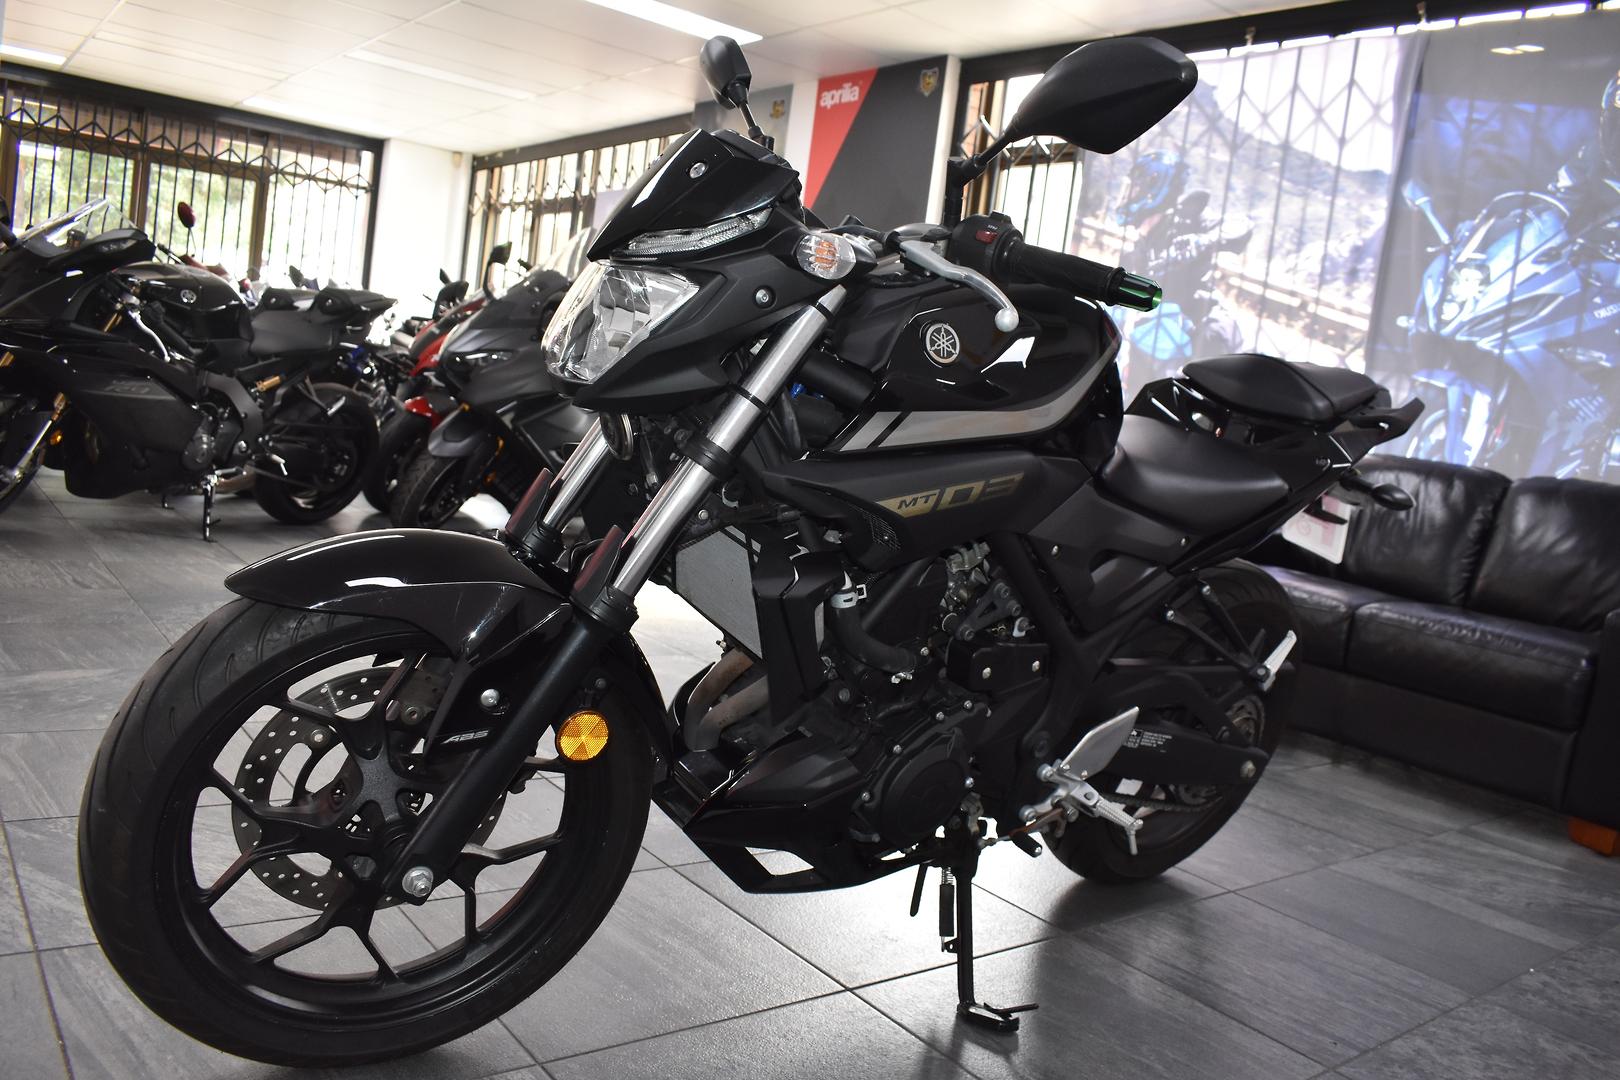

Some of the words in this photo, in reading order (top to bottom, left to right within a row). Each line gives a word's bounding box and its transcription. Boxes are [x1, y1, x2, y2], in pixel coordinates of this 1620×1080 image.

[820, 82, 859, 109] aprilia
[898, 493, 936, 509] MT
[936, 472, 1024, 511] 03
[442, 730, 488, 744] ABS
